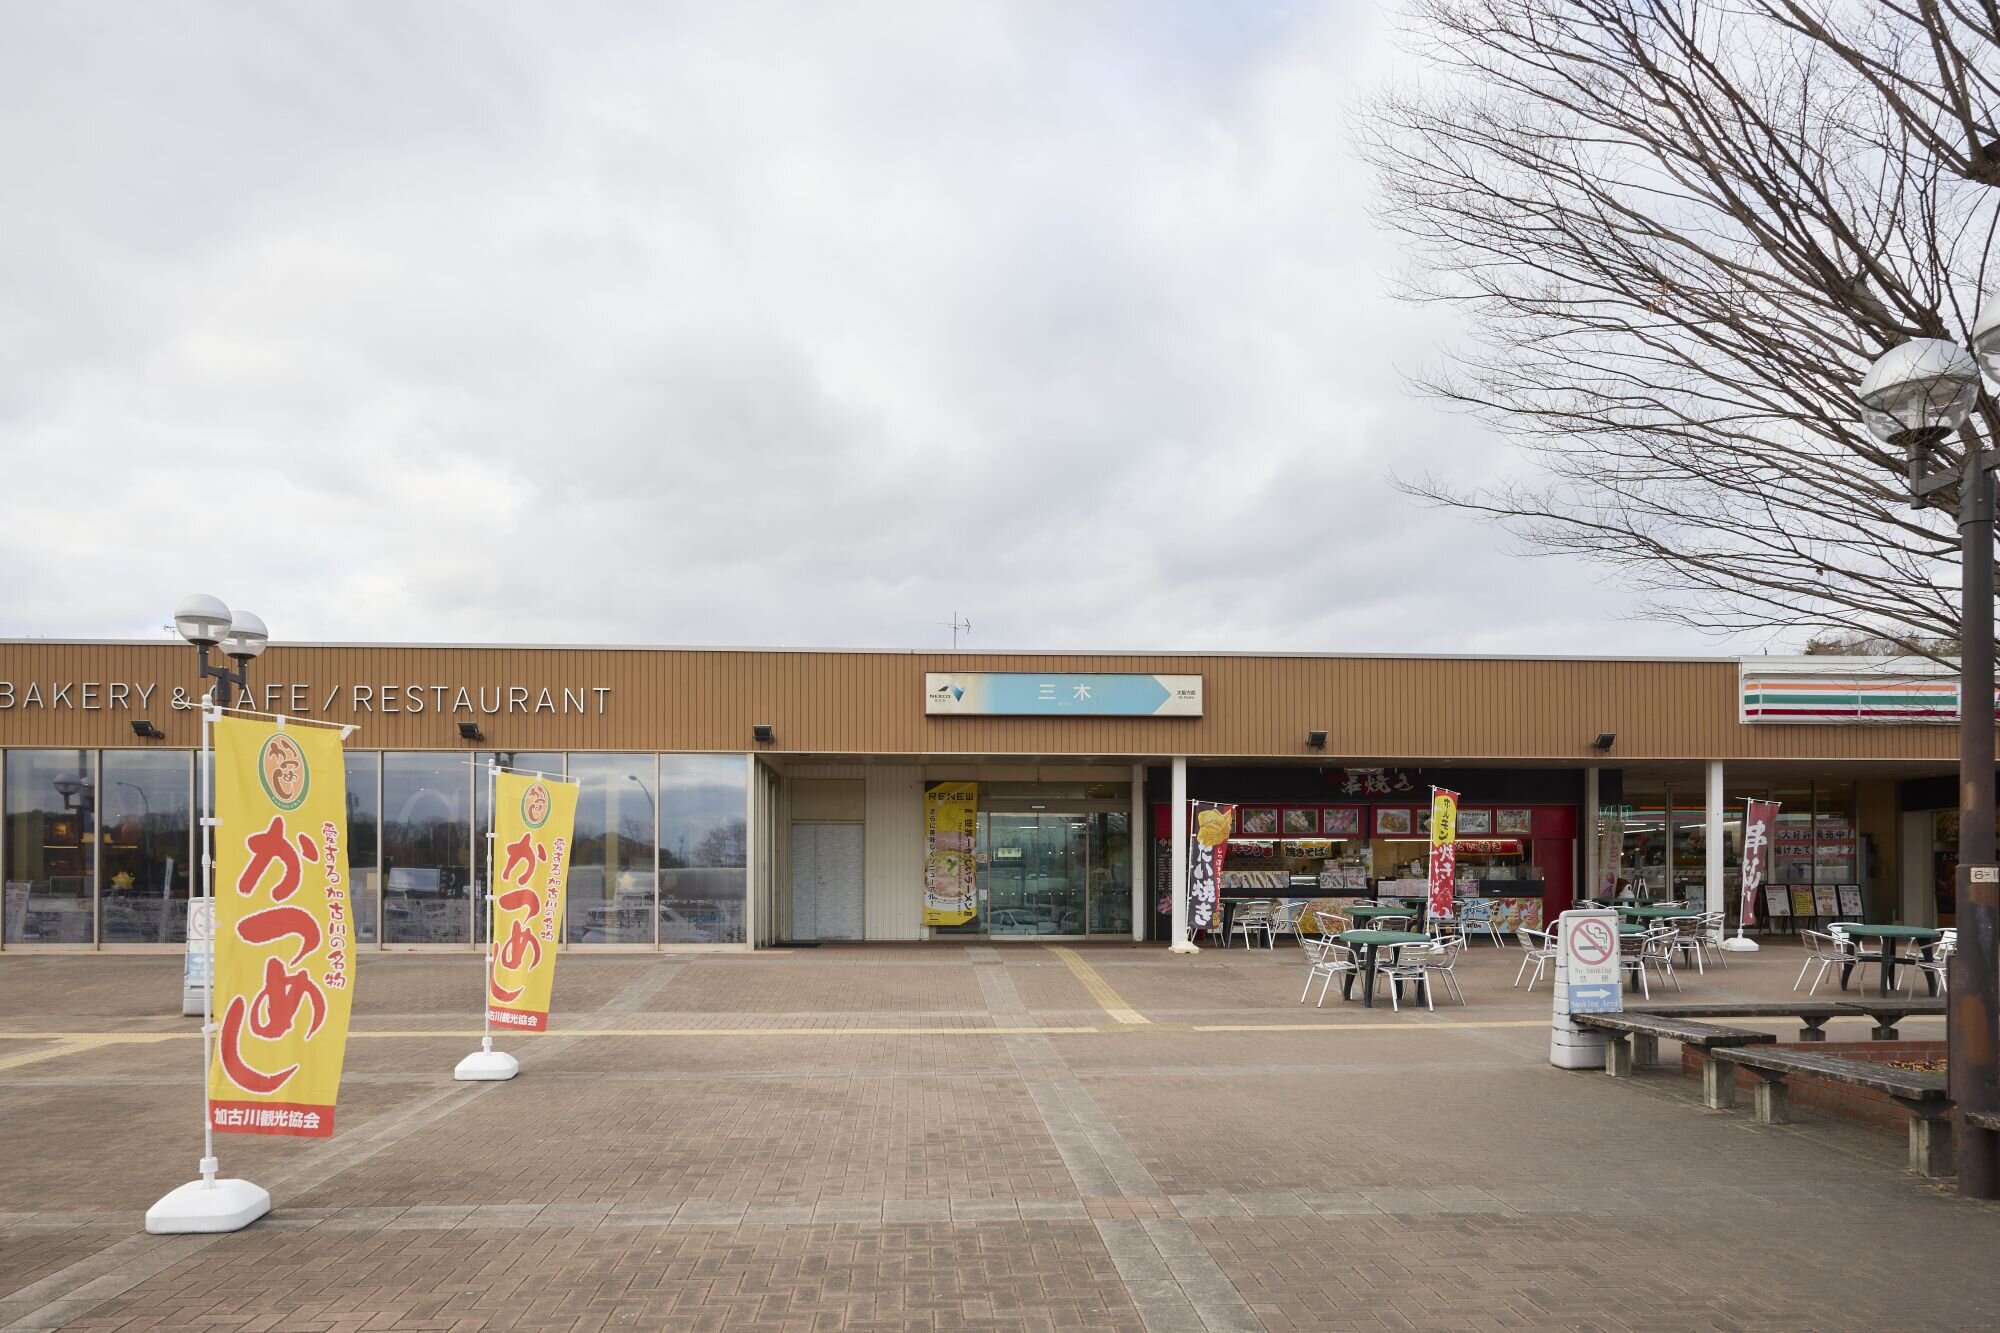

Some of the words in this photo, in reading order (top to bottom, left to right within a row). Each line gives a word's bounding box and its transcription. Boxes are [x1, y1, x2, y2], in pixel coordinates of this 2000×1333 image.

[0, 681, 156, 710] BAKERY
[171, 686, 192, 711] &
[208, 684, 309, 711] AFE
[353, 685, 611, 714] RESTAURANT
[1038, 684, 1091, 701] 三木
[928, 792, 974, 801] RENEW
[1438, 798, 1451, 841] ホルモン
[540, 837, 566, 942] 愛する加古川の名物
[1193, 840, 1216, 926] たい焼き
[322, 821, 347, 989] 愛する加古川の名物
[489, 831, 543, 1004] かつめし
[219, 815, 328, 1095] かつめし
[1586, 967, 1612, 975] Smoking
[488, 1010, 538, 1027] 古川観光協会
[213, 1106, 321, 1130] 加古川観光協会
